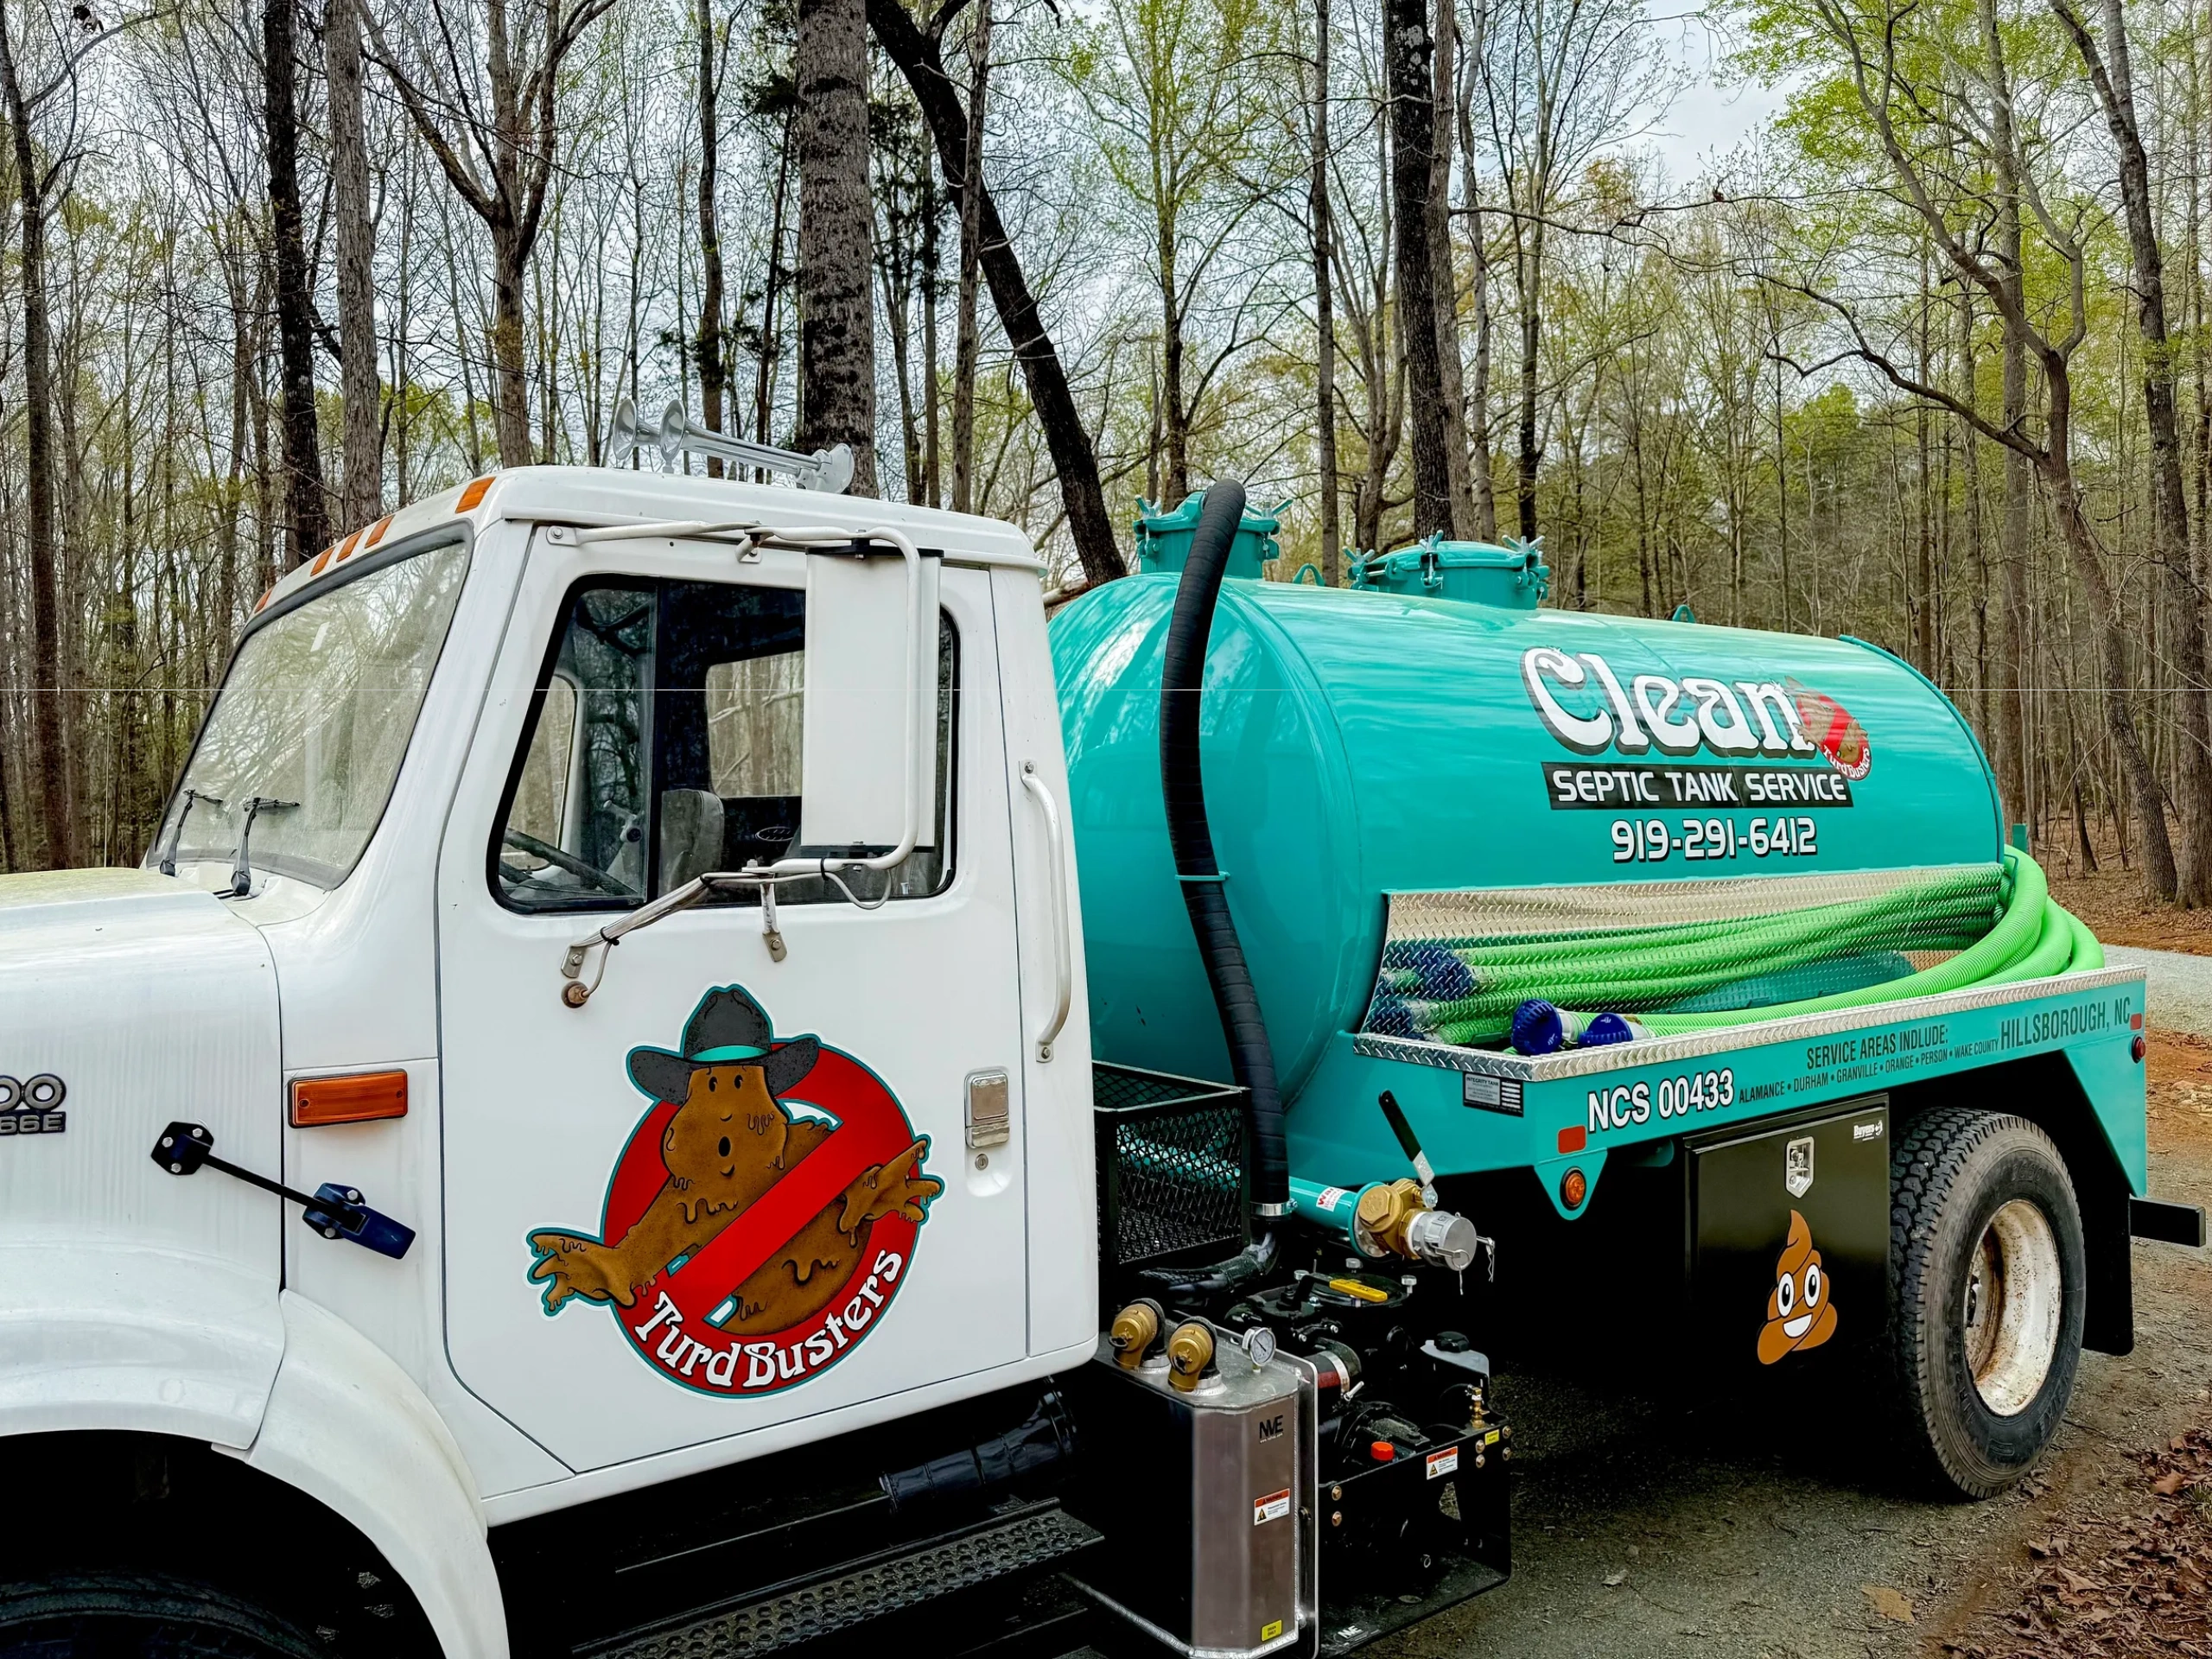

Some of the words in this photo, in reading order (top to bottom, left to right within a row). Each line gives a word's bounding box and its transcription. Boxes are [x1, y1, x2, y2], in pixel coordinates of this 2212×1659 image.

[1521, 645, 1815, 756] Clean
[1554, 769, 1660, 803] SEPTIC
[1670, 771, 1742, 802] TANK
[1746, 772, 1847, 802] SERVICE
[1611, 817, 1818, 863] 919-291-6412
[2000, 1001, 2109, 1050] HILLSBOROUGH,
[2114, 996, 2131, 1026] NC
[1738, 1081, 1784, 1103] ALAMANCE
[1793, 1072, 1828, 1092] DURHAM
[1837, 1062, 1878, 1083] GRANVILLE
[1885, 1055, 1914, 1073] ORANGE
[1920, 1048, 1948, 1065] PERSON
[1955, 1044, 1973, 1058] WAKE
[1974, 1039, 1999, 1055] COUNTY
[1807, 1040, 1856, 1070] SERVICE
[1859, 1033, 1897, 1059] AREAS
[1466, 1076, 1488, 1085] INTEGRITY
[1587, 1081, 1651, 1134] NCS
[1657, 1067, 1735, 1120] 00433
[634, 1249, 903, 1389] TurdBusters
